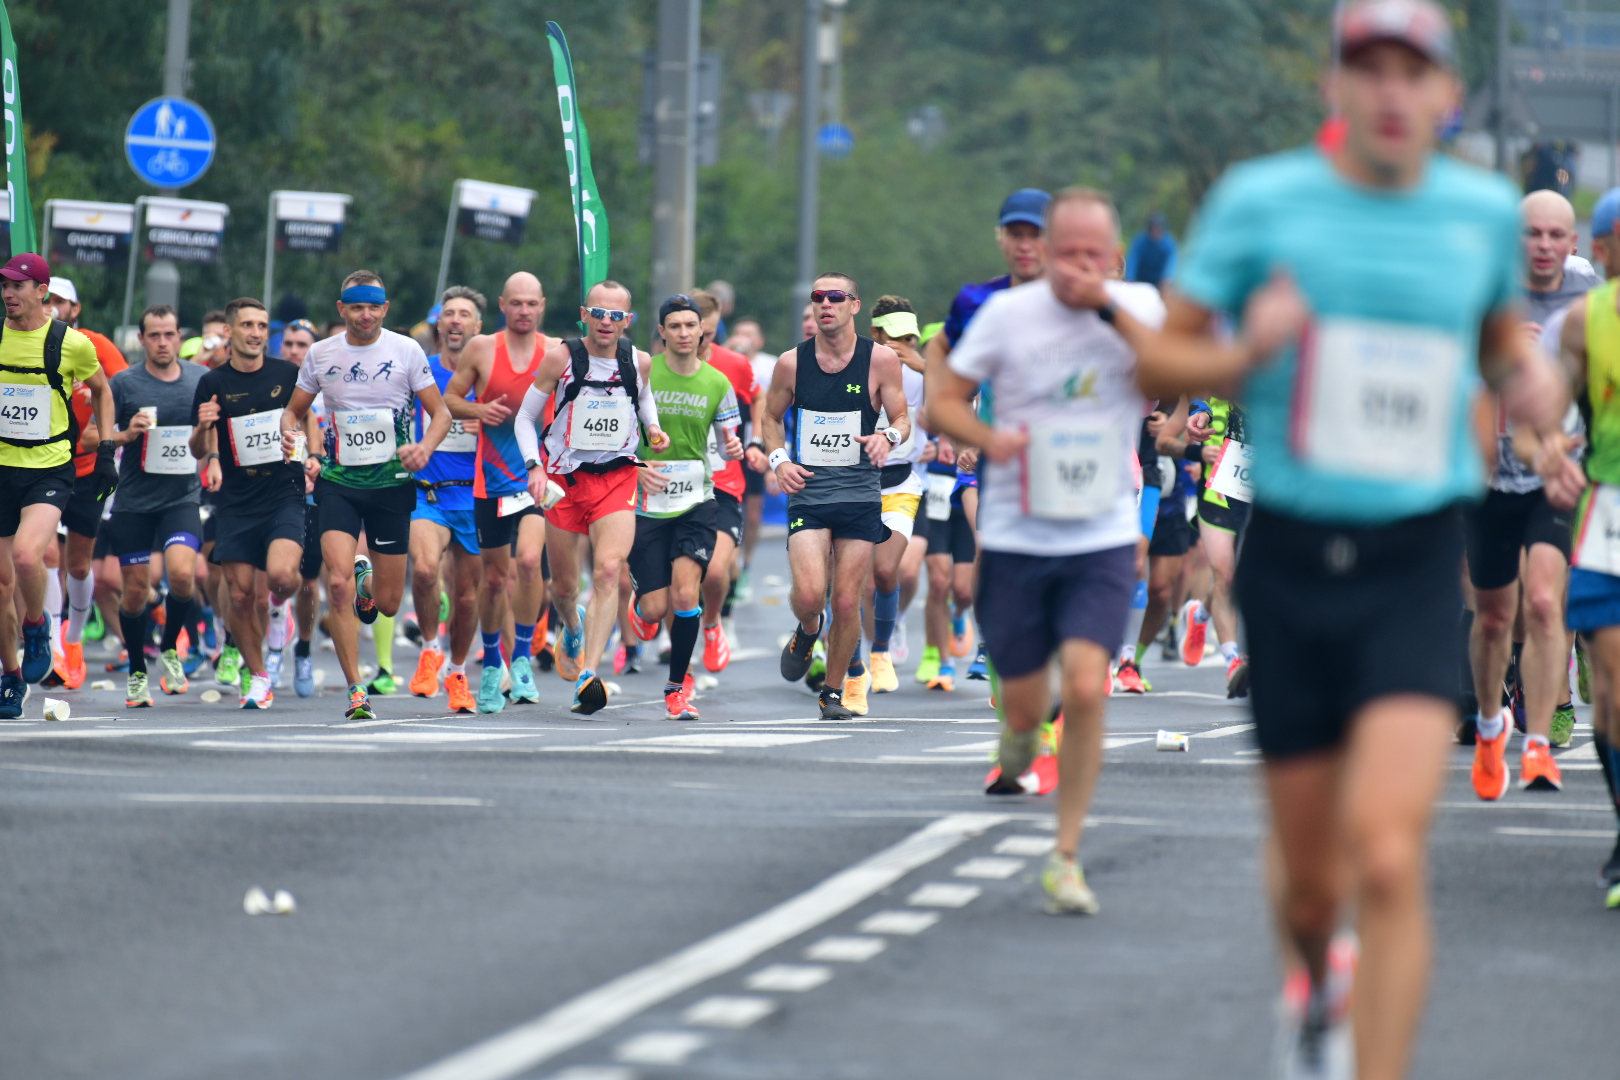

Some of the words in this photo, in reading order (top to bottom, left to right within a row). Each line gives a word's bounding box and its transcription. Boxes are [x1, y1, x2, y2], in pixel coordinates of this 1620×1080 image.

[67, 231, 116, 249] OWOCE
[3, 387, 15, 397] 22
[587, 400, 600, 409] 22
[1, 405, 38, 420] 4219
[347, 415, 358, 424] 22
[583, 418, 619, 432] 4618
[813, 415, 826, 425] 22
[245, 431, 281, 448] 2734
[345, 430, 386, 447] 3080
[810, 433, 851, 448] 4473
[161, 445, 187, 458] 263
[661, 464, 673, 473] 22
[1233, 464, 1252, 482] 10
